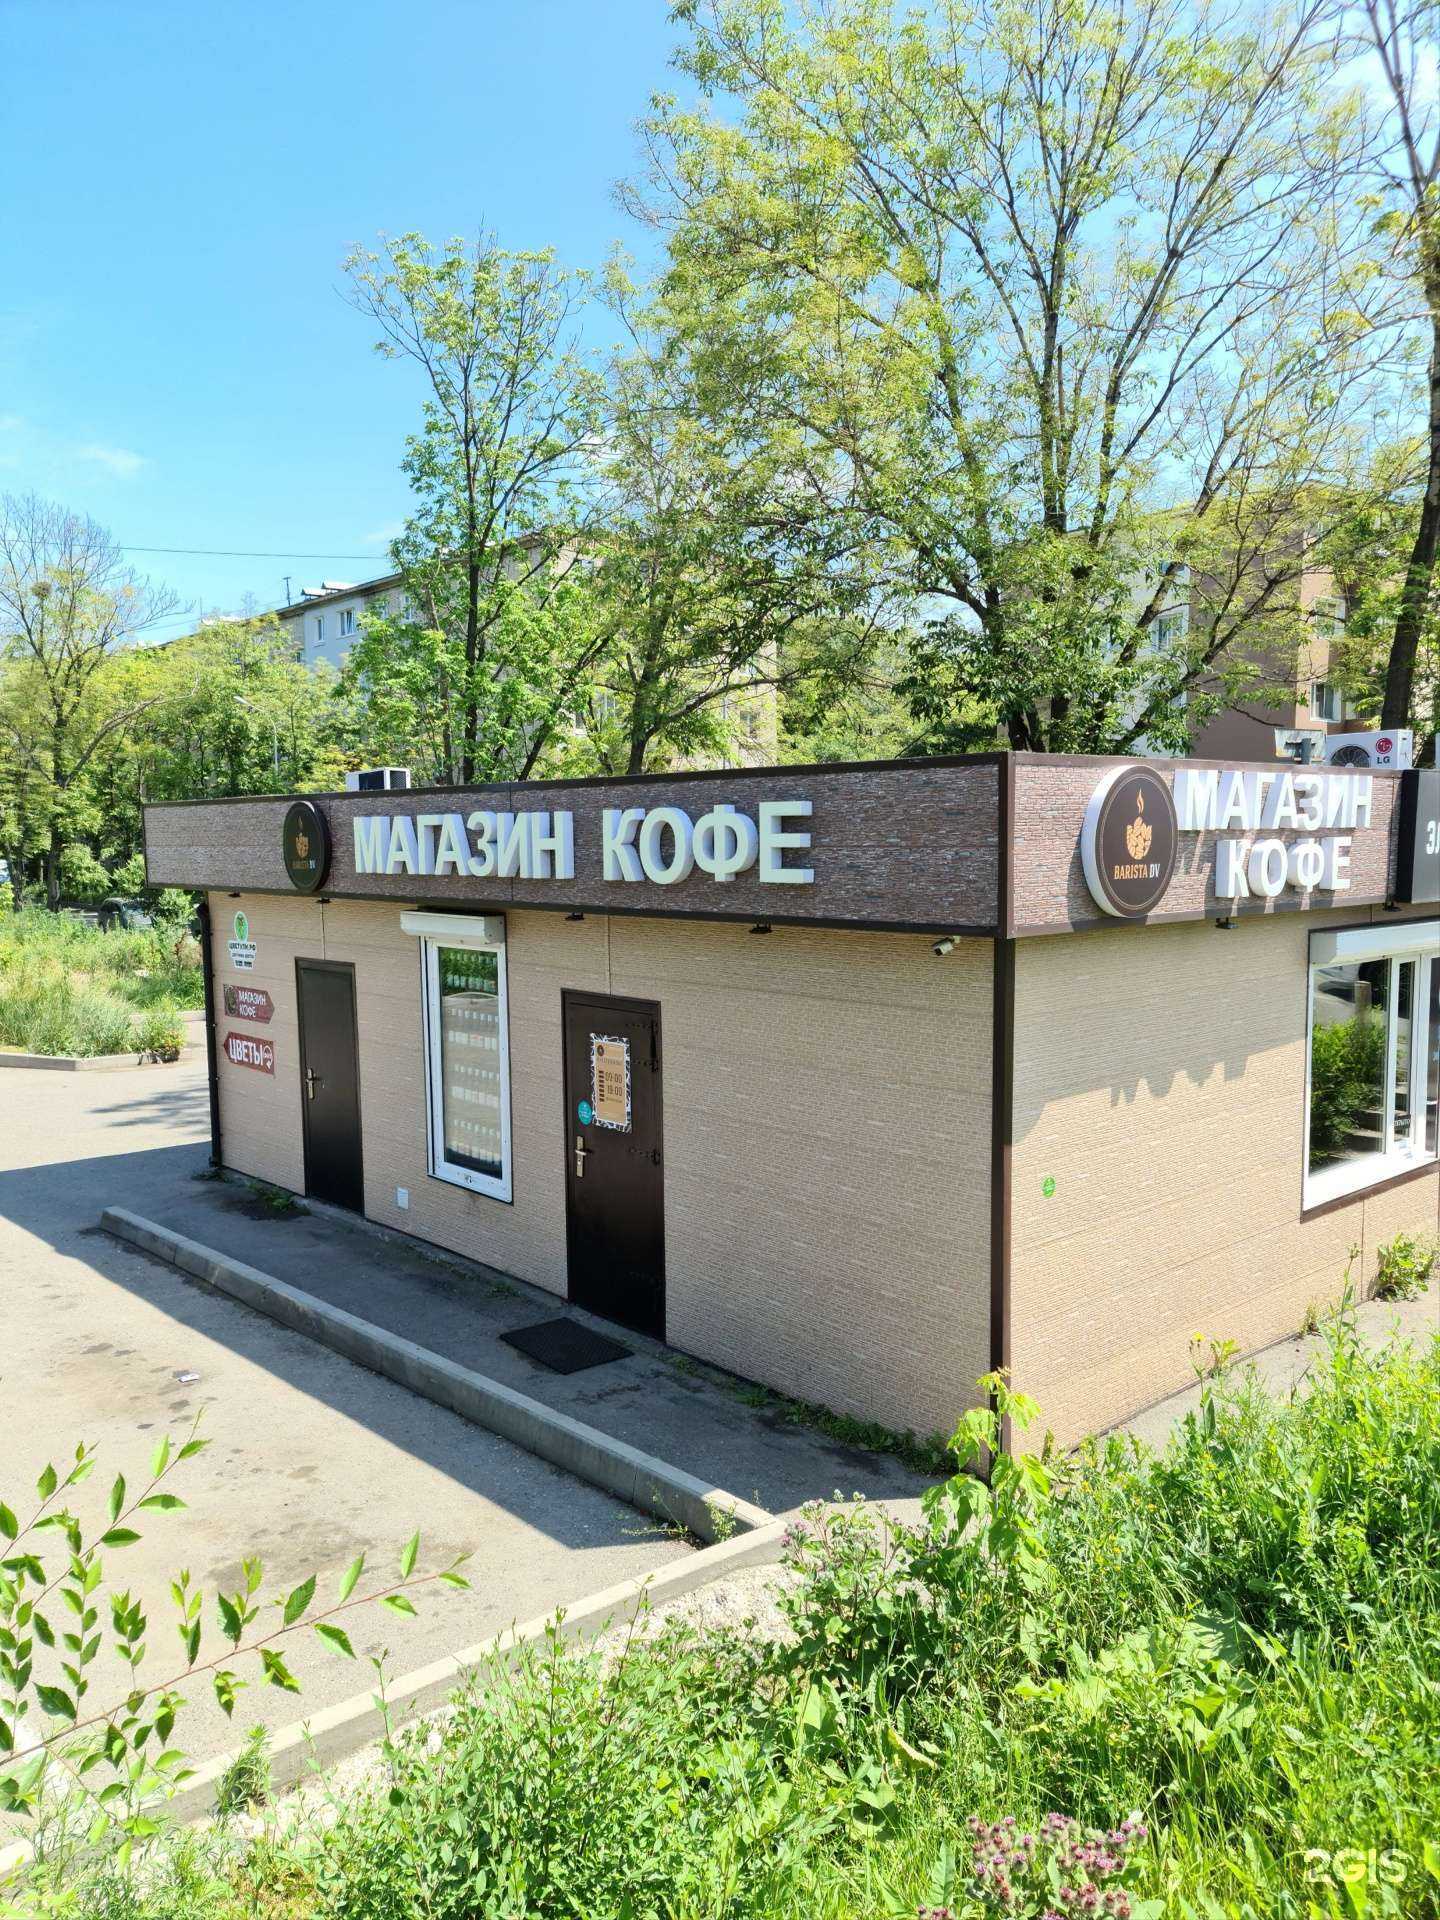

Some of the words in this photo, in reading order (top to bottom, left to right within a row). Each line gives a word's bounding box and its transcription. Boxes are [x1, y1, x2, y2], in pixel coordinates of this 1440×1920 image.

[1377, 756, 1390, 764] LG
[1173, 769, 1373, 831] МАГАЗИН
[353, 811, 574, 879] МАГАЗИН
[602, 801, 814, 884] КОФЕ
[1114, 864, 1148, 880] BARISTA
[1149, 863, 1160, 878] DV
[1215, 837, 1352, 898] КОФЕ
[238, 990, 266, 1006] МАГАЗИН
[239, 1004, 257, 1018] КОФЕ
[229, 1038, 264, 1066] ЦВЕТЫ
